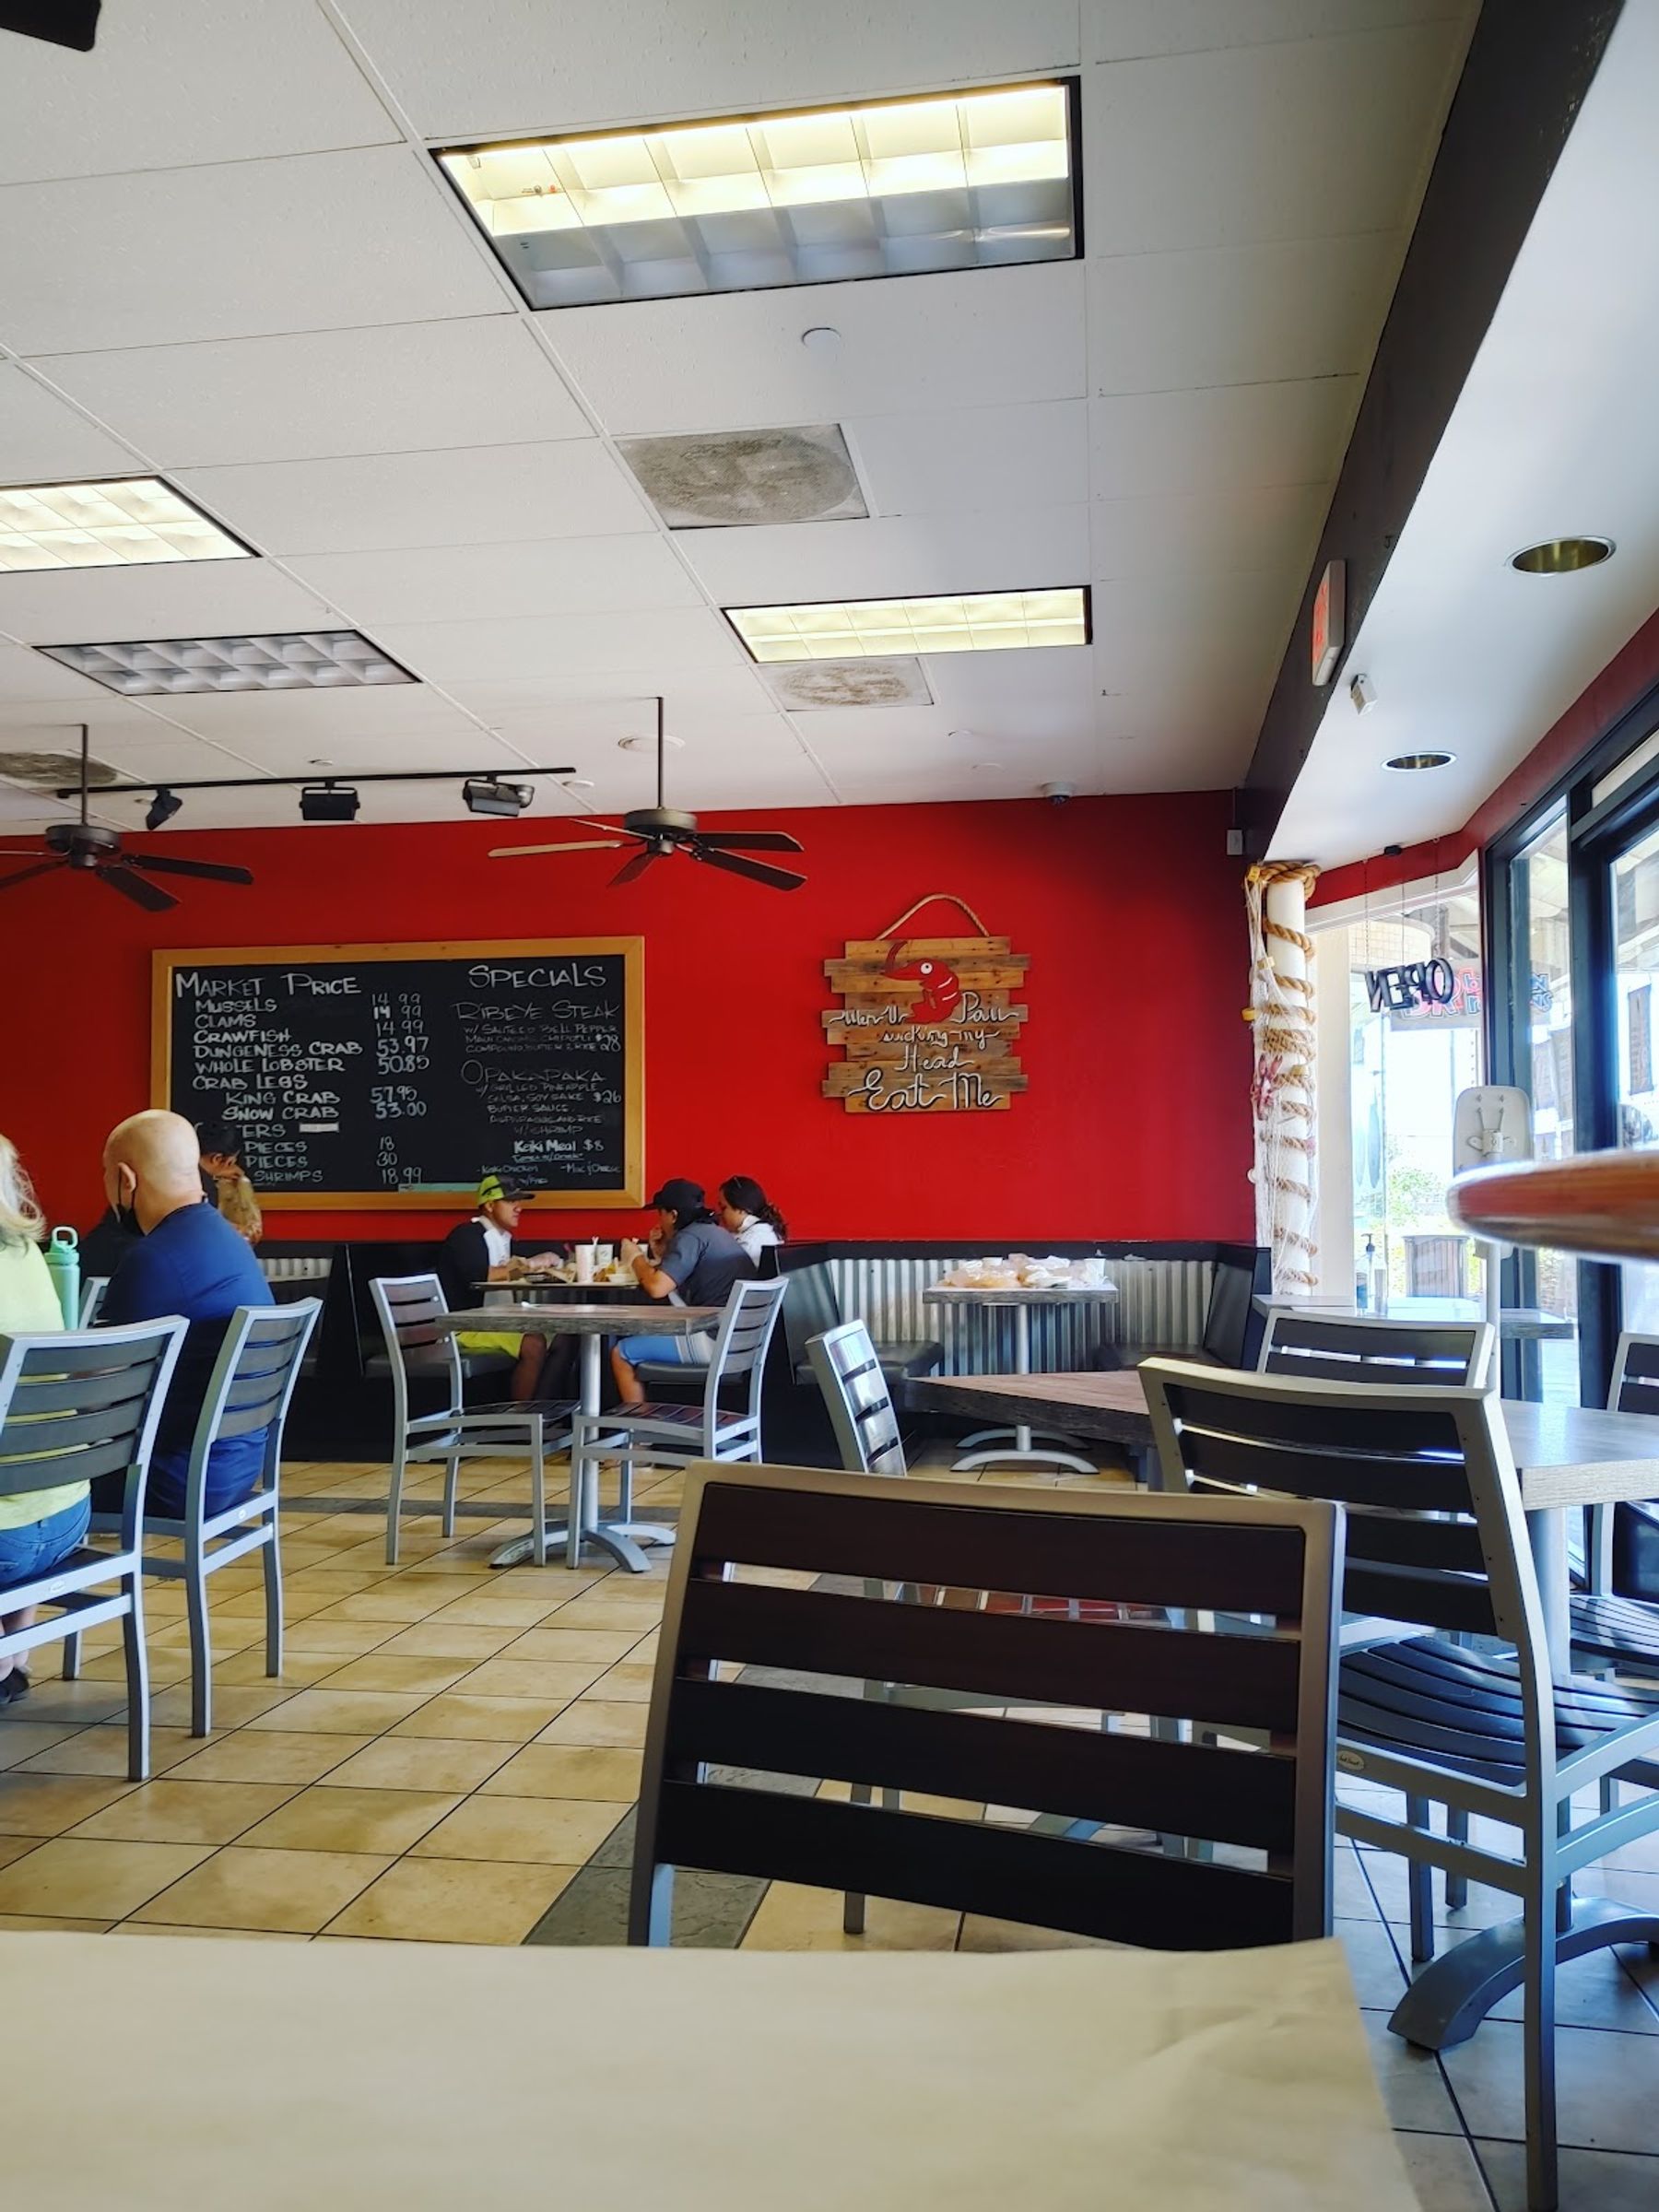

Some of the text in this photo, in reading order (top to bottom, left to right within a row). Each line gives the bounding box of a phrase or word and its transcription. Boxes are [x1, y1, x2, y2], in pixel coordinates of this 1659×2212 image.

[175, 971, 362, 998] MARKET PRICE
[468, 962, 607, 989] SPECIALS
[194, 997, 277, 1013] MUSSELS
[551, 999, 620, 1020] STEAK
[194, 1014, 257, 1030] CLAMS
[194, 1028, 293, 1044] CRAWFISH
[193, 1035, 429, 1059] DUNGENESS CRAB 53.97
[194, 1058, 255, 1075] WHOLE
[262, 1057, 347, 1073] LOBSTER
[894, 1045, 975, 1072] Head
[461, 1059, 607, 1085] OPAKAPAKA
[192, 1073, 309, 1090] CRAB LEGS
[848, 1069, 1004, 1111] Eat Me
[226, 1091, 277, 1105] KING
[282, 1090, 341, 1105] CRAB
[221, 1106, 274, 1122] SNOW
[282, 1106, 340, 1121] CRAB
[244, 1135, 395, 1154] PIECES 18
[546, 1138, 576, 1152] Meal
[244, 1151, 398, 1169] PIECES 30
[253, 1170, 324, 1182] SHRIMPS
